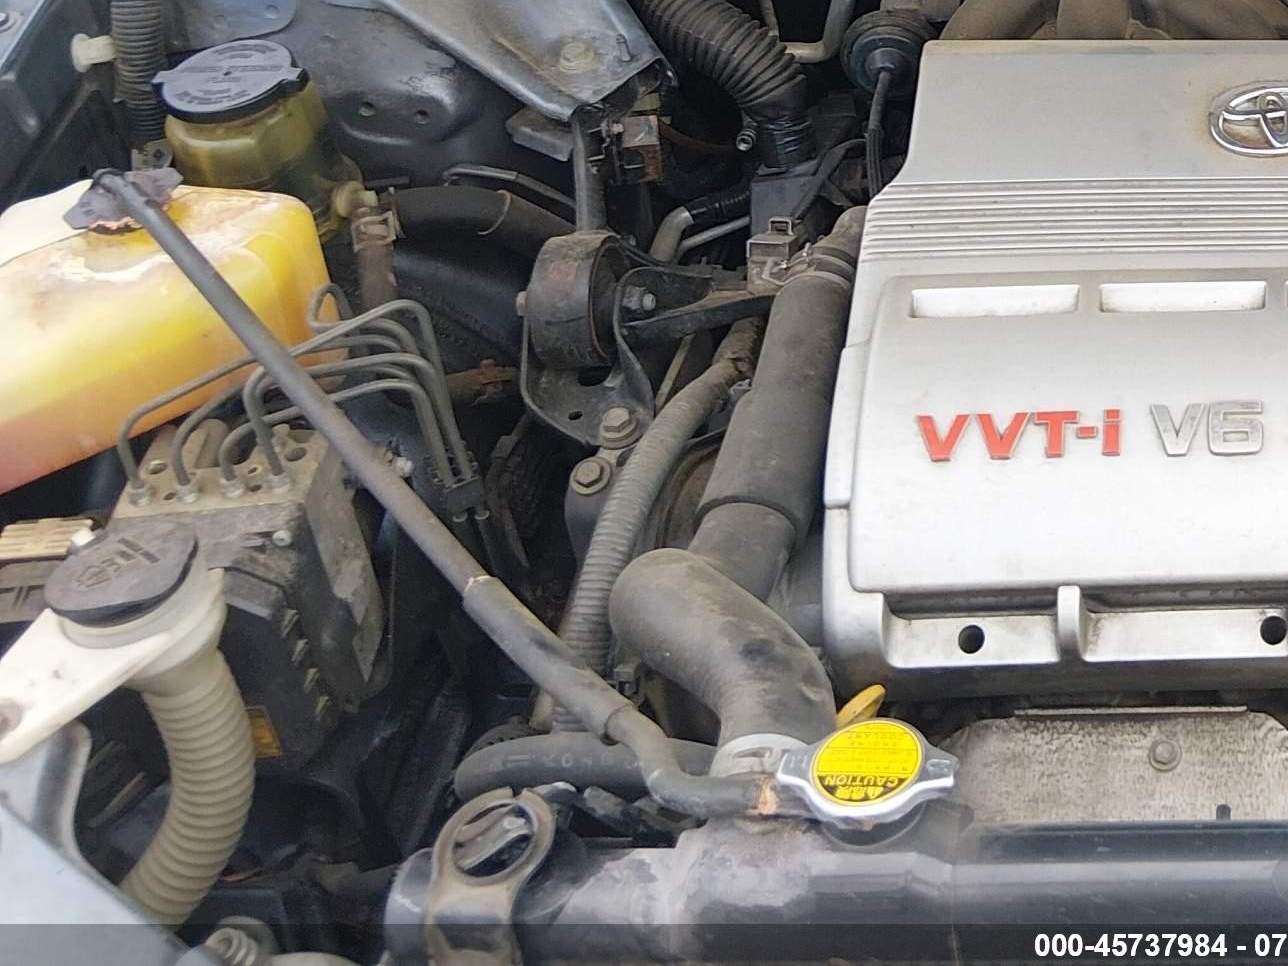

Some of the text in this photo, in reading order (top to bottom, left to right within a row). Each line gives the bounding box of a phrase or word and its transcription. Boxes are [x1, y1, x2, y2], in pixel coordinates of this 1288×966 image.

[917, 408, 1121, 462] VVT-i
[1149, 400, 1265, 458] V6
[824, 775, 899, 787] CAUTION
